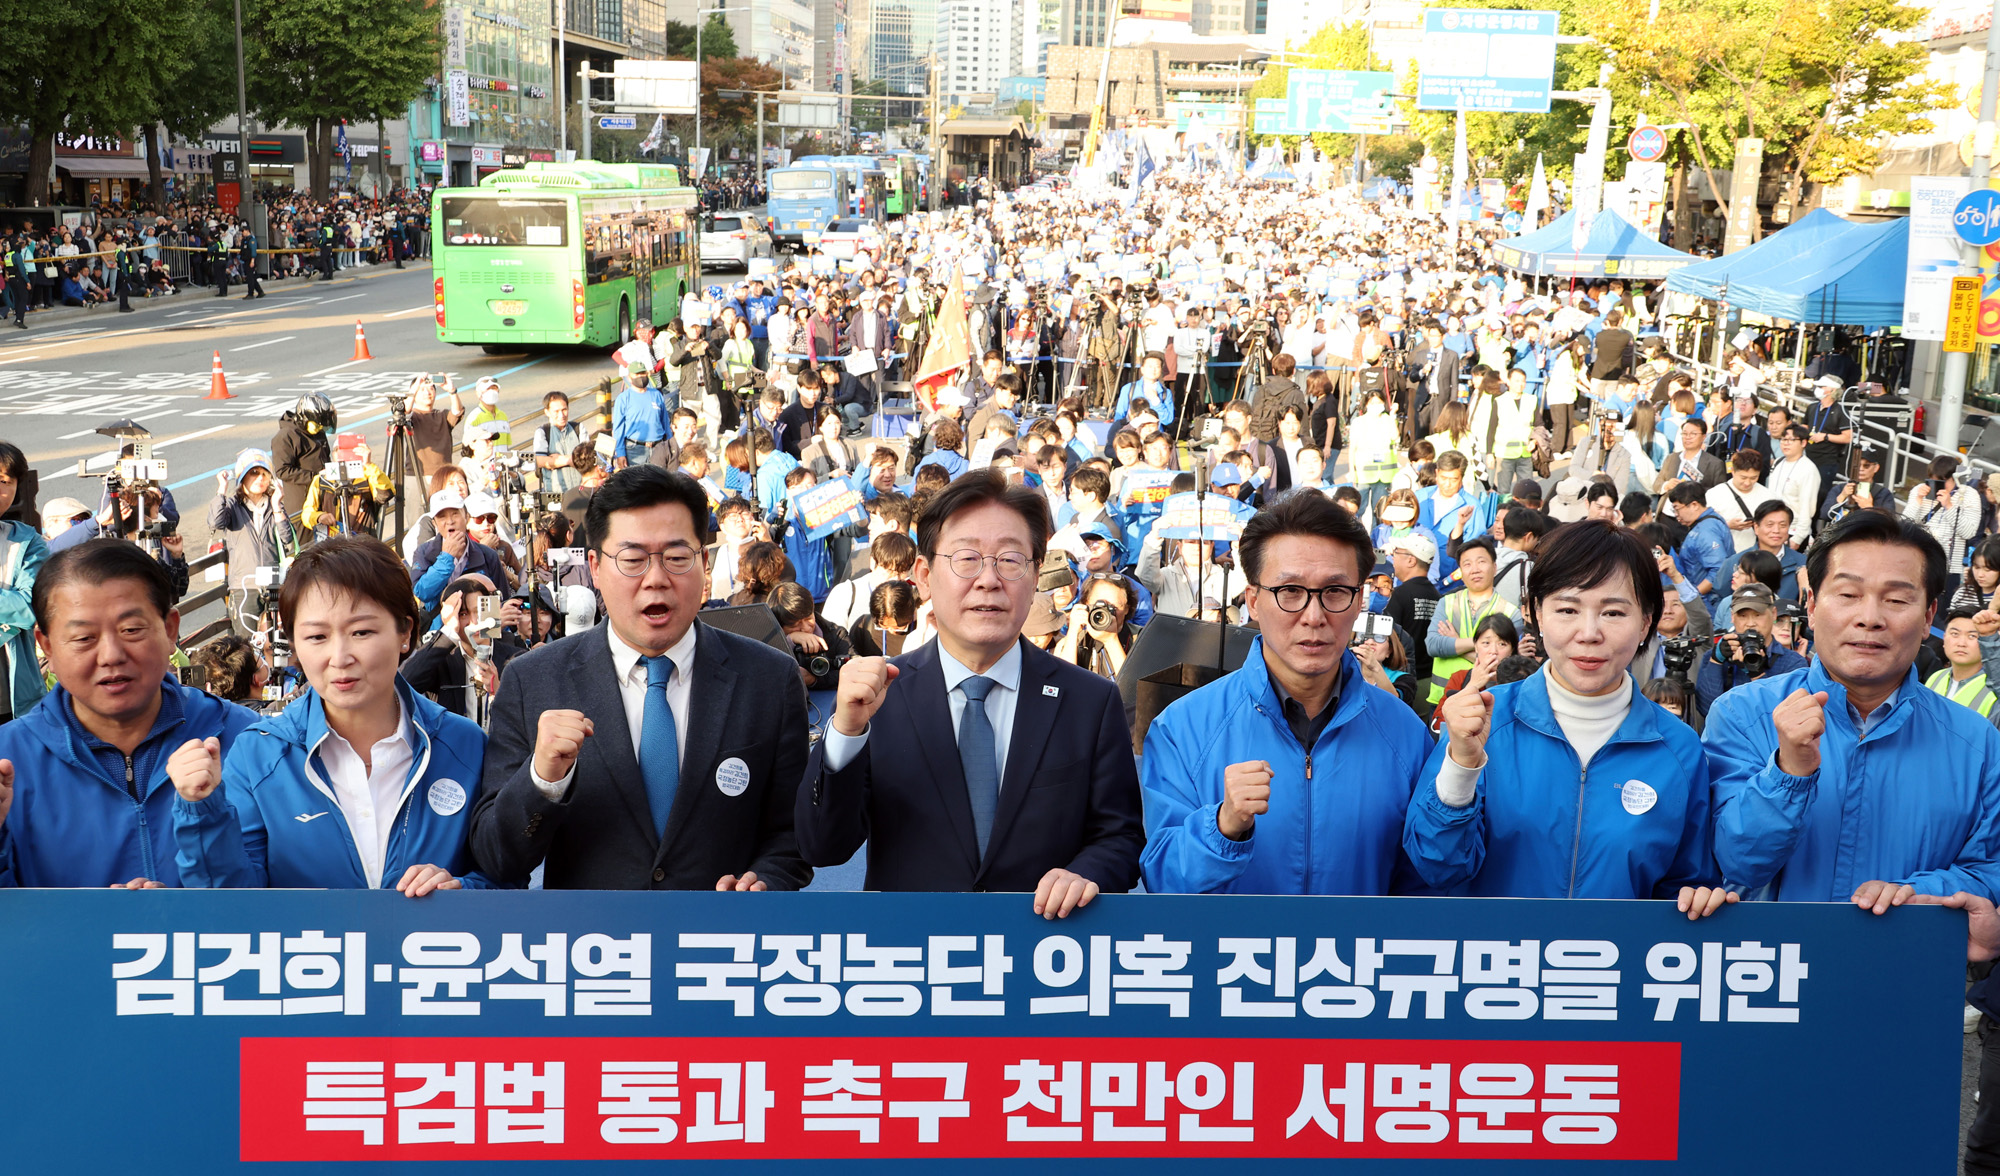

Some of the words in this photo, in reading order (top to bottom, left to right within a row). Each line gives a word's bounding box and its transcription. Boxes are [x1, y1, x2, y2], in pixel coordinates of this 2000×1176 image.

[424, 143, 436, 156] 약
[473, 149, 484, 161] 약
[814, 179, 827, 188] 201
[1917, 189, 1956, 201] 공공디자인
[1931, 198, 1961, 208] 페스티
[1739, 194, 1752, 231] 서울역
[1930, 206, 1953, 215] 2024
[1604, 259, 1632, 275] 행사
[1953, 293, 1964, 311] 불법
[113, 931, 652, 1017] 김건희·윤석열
[676, 933, 1013, 1017] 국정농단
[1031, 935, 1193, 1018] 의혹
[1218, 937, 1621, 1021] 진상규명을
[1643, 942, 1808, 1023] 위한
[303, 1061, 565, 1146] 특검법
[598, 1061, 775, 1144] 통과
[802, 1060, 970, 1143] 촉구
[1003, 1060, 1254, 1142] 천만인
[1286, 1063, 1620, 1145] 서명운동
